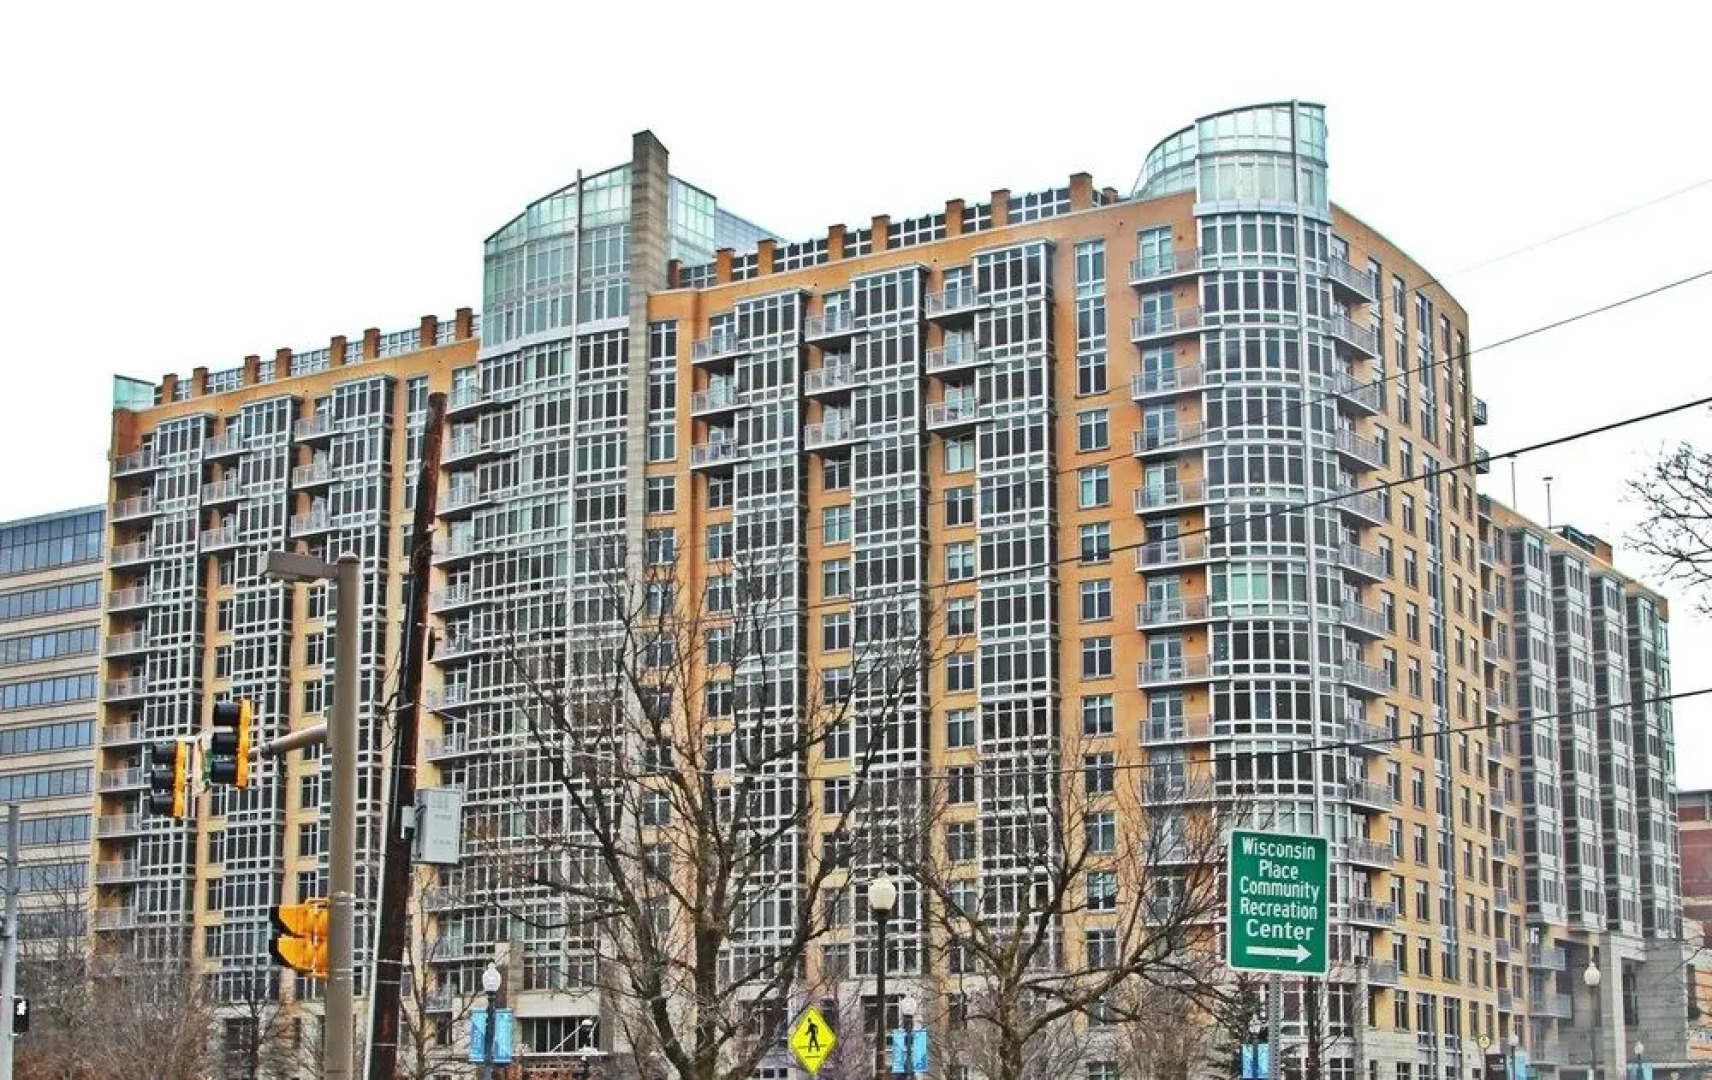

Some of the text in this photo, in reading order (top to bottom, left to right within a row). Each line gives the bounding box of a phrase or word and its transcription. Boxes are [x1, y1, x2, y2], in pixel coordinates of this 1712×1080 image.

[1242, 837, 1315, 860] Wisconsin
[1259, 859, 1299, 879] Place
[1240, 876, 1319, 903] Community
[1240, 897, 1317, 919] Recreation
[1246, 919, 1314, 940] Center
